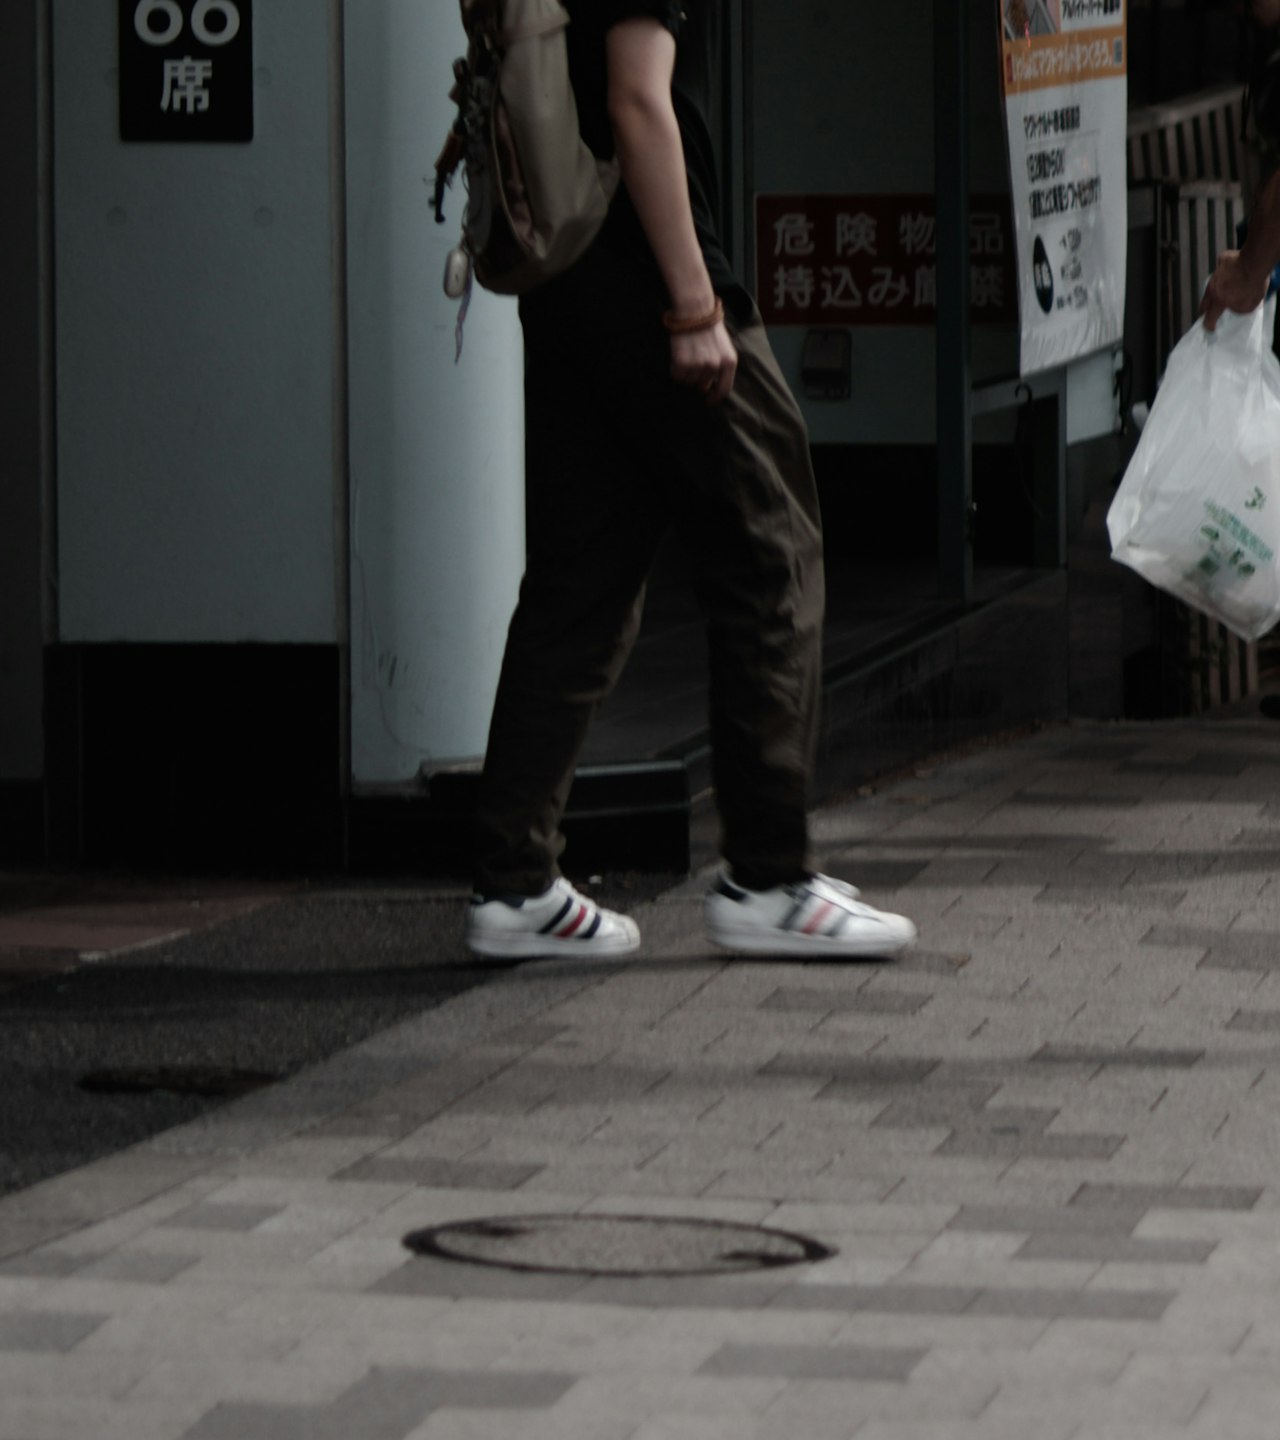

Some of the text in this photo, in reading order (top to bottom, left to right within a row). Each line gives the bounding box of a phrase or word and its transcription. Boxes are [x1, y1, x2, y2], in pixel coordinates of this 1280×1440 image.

[159, 54, 214, 116] 席
[772, 211, 1005, 257] 危険物品
